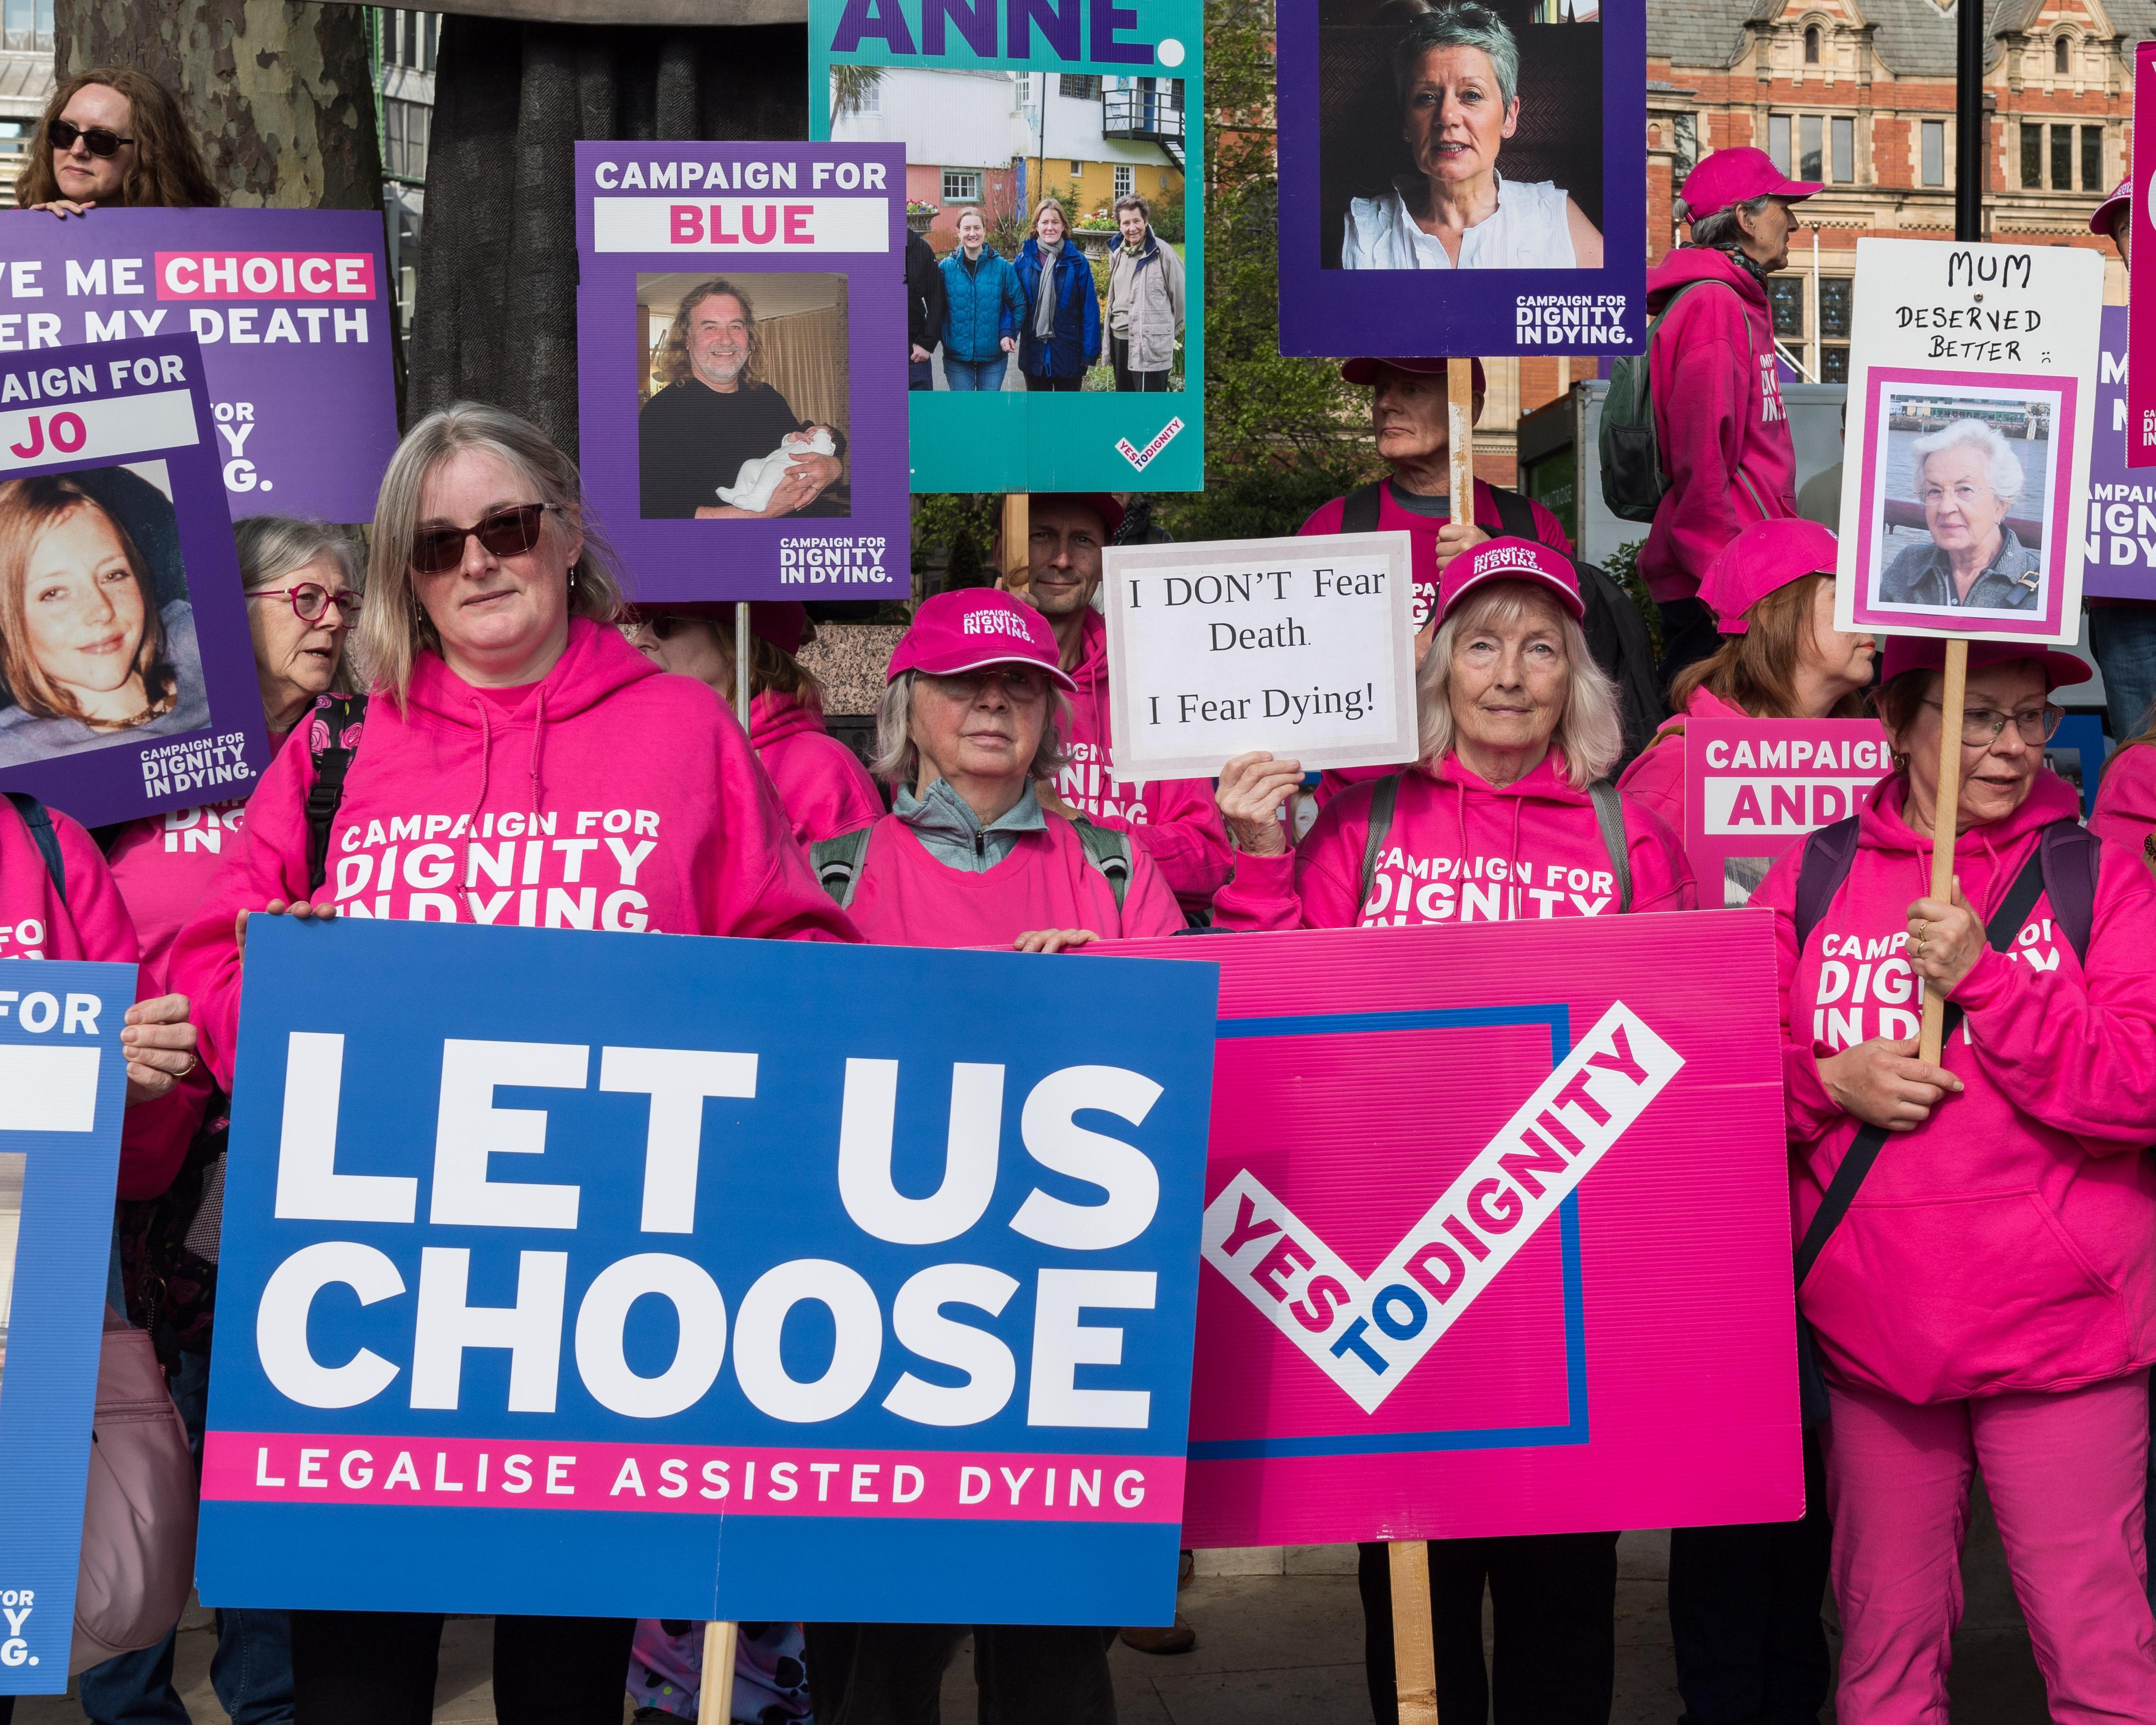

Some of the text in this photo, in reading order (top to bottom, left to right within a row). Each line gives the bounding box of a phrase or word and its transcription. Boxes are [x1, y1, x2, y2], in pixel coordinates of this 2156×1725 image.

[830, 0, 1185, 67] ANNE.
[595, 162, 887, 190] CAMPAIGN FOR
[670, 205, 814, 244] BLUE
[66, 258, 145, 296] ME
[165, 257, 367, 294] CHOICE
[1948, 251, 2031, 289] MUM
[1516, 295, 1626, 306] CAMPAIGN FOR
[1516, 307, 1626, 325] DIGNITY
[0, 308, 369, 350] ER MY DEATH
[1516, 326, 1633, 344] IN DYING.
[1895, 306, 2041, 332] DESERVED
[1927, 335, 2021, 361] BETTER
[1, 355, 187, 403] AIGN FOR
[210, 402, 255, 421] OR
[10, 411, 87, 459] JO
[1120, 441, 1138, 461] YES
[780, 537, 886, 548] CAMPAIGN FOR
[780, 548, 885, 566] DIGNITY
[1474, 547, 1537, 560] CAMPAIGN FOR
[781, 566, 893, 584] IN DYING.
[1473, 558, 1543, 574] IN DYING.
[1474, 551, 1537, 568] DIGNITY
[1129, 579, 1142, 608] I
[1313, 568, 1385, 597] Fear
[963, 609, 1010, 618] CAMPAIGN
[964, 615, 1026, 631] DIGNITY
[964, 624, 1035, 644] IN DYING.
[1209, 617, 1312, 651] Death.
[1149, 682, 1374, 725] I Fear Dying!
[141, 731, 245, 761] CAMPAIGN FOR
[142, 742, 246, 780] DIGNITY
[145, 762, 257, 798] IN DYING.
[165, 828, 221, 854] IN
[341, 809, 660, 852] CAMPAIGN FOR
[334, 837, 658, 901] DIGNITY
[1374, 847, 1613, 895] CAMPAIGN FOR
[1365, 873, 1613, 922] DIGNITY
[1822, 931, 1911, 961] CAMP
[1813, 1007, 1863, 1052] IN
[275, 1031, 1166, 1251] LET US
[1220, 1192, 1351, 1333] YES
[256, 1241, 1158, 1429] CHOOSE
[255, 1447, 1148, 1509] LEGALISE ASSISTED DYING
[0, 1590, 35, 1606] OR
